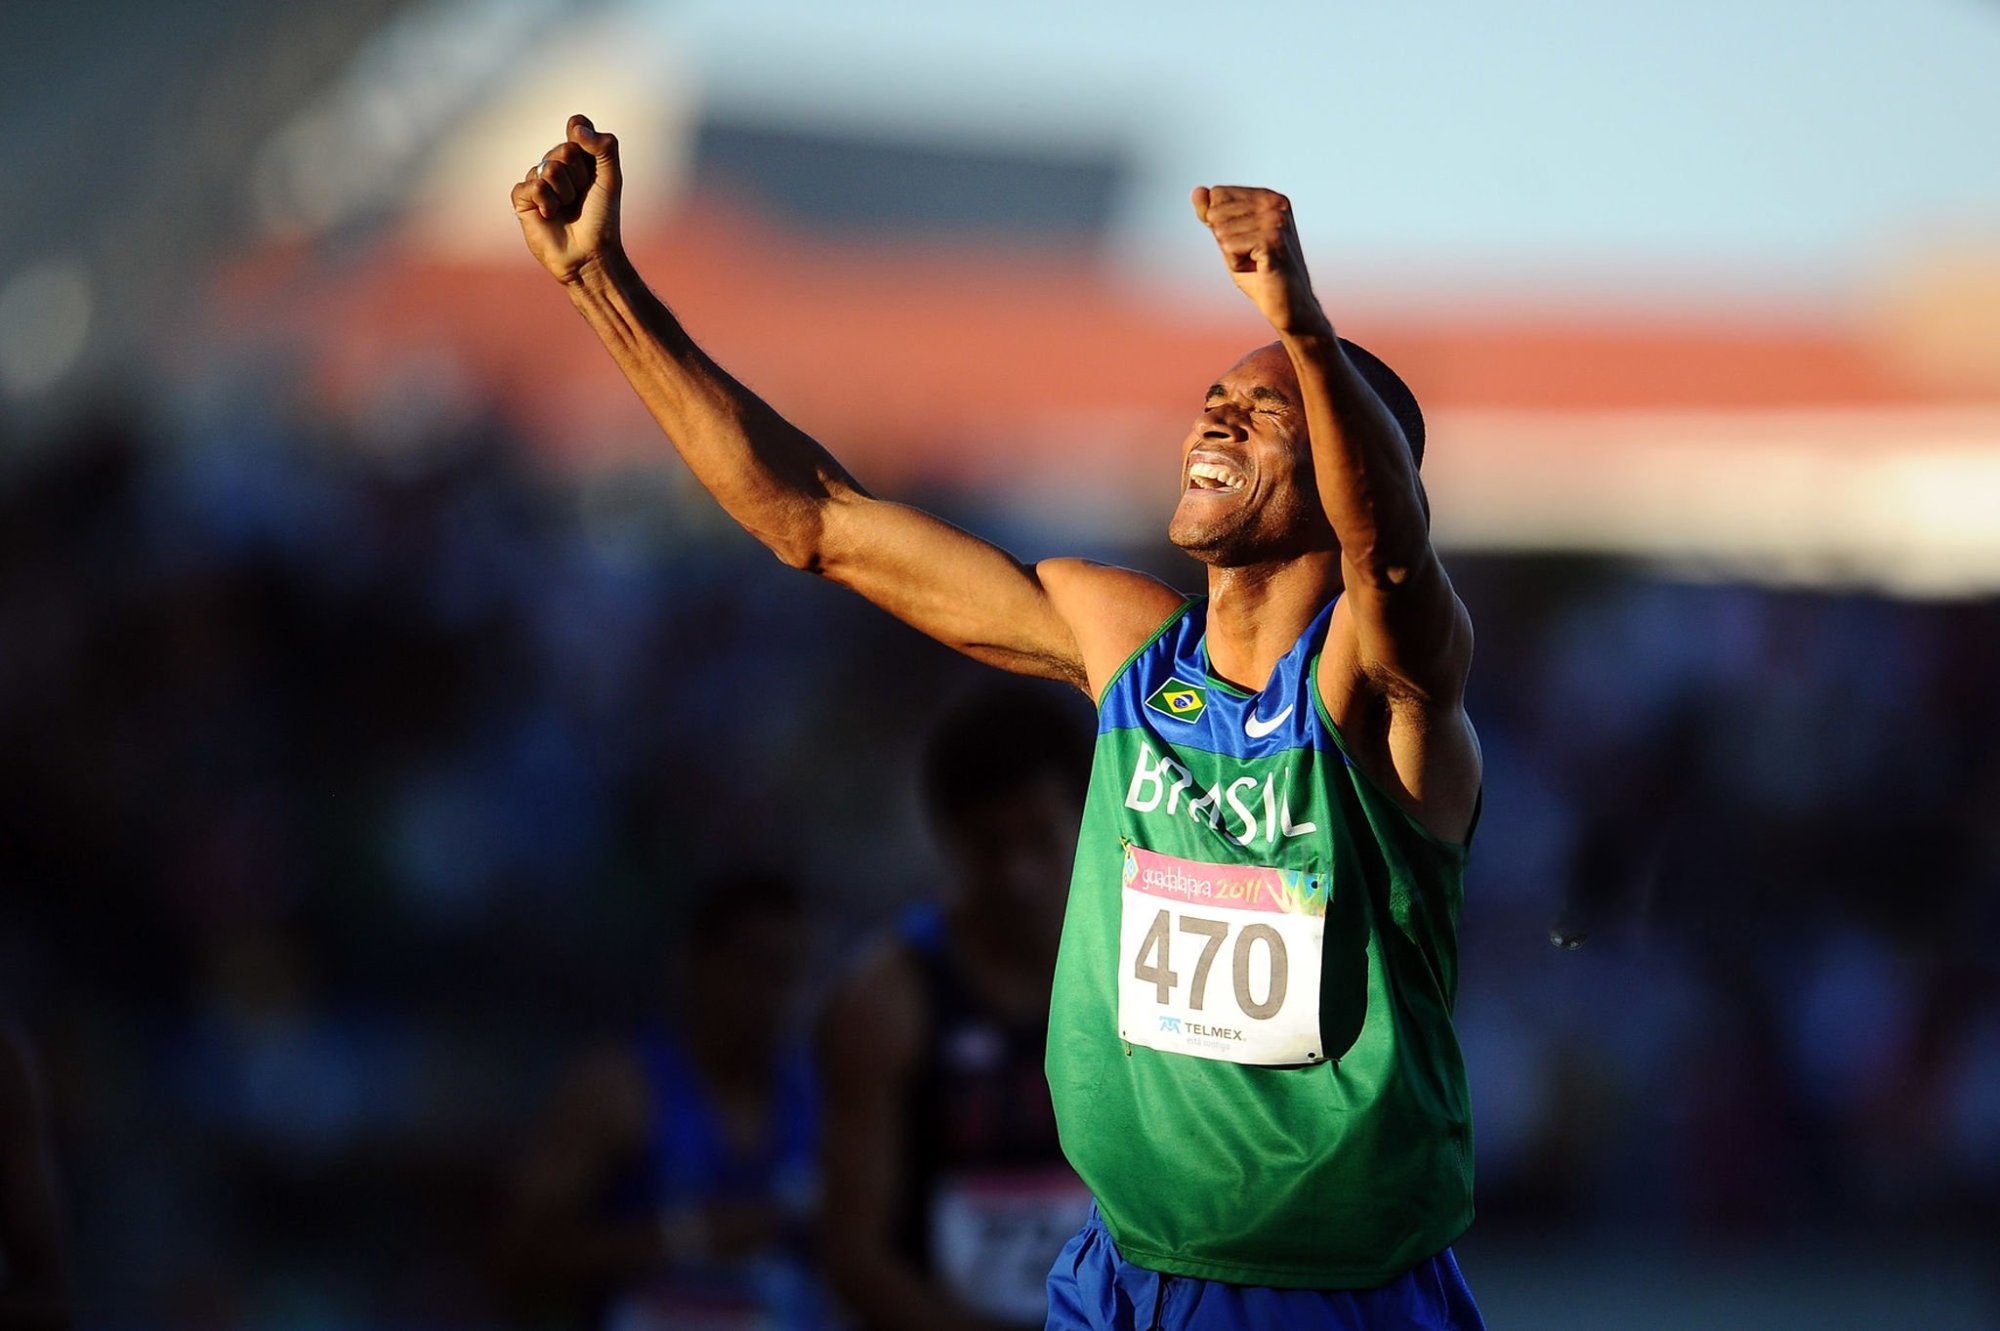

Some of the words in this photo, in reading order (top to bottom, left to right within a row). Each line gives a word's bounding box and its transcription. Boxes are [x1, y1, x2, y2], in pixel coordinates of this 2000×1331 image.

[1124, 741, 1317, 846] BRASIL
[1214, 878, 1262, 904] 2011
[1134, 908, 1289, 1021] 470
[1184, 1022, 1243, 1041] TELMEX
